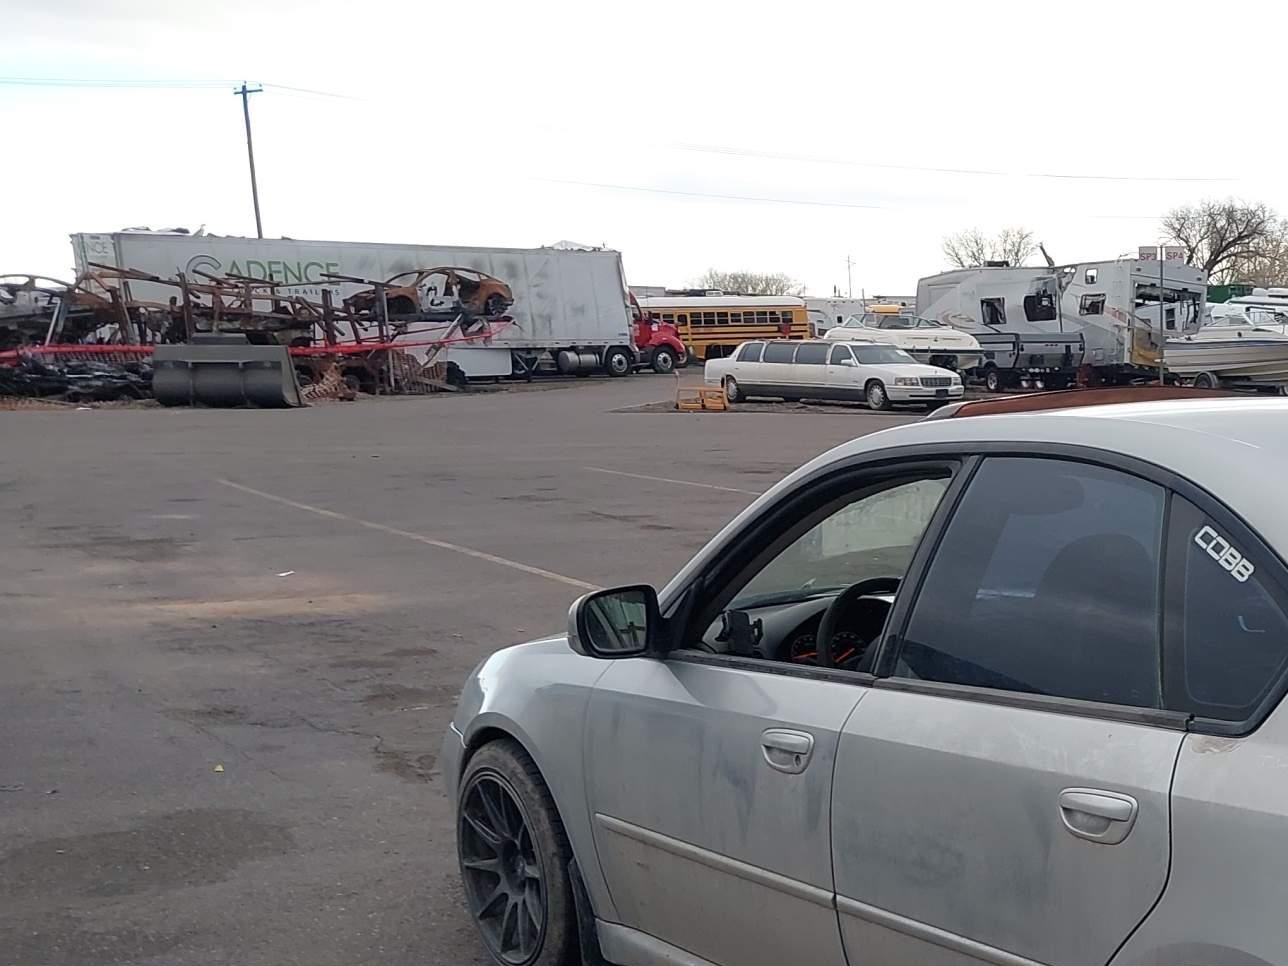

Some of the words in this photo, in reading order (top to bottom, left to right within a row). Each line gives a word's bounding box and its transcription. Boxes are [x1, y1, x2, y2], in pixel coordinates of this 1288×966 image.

[1166, 252, 1184, 260] SP4
[287, 288, 341, 296] TRAILS
[1195, 525, 1255, 582] COBB
